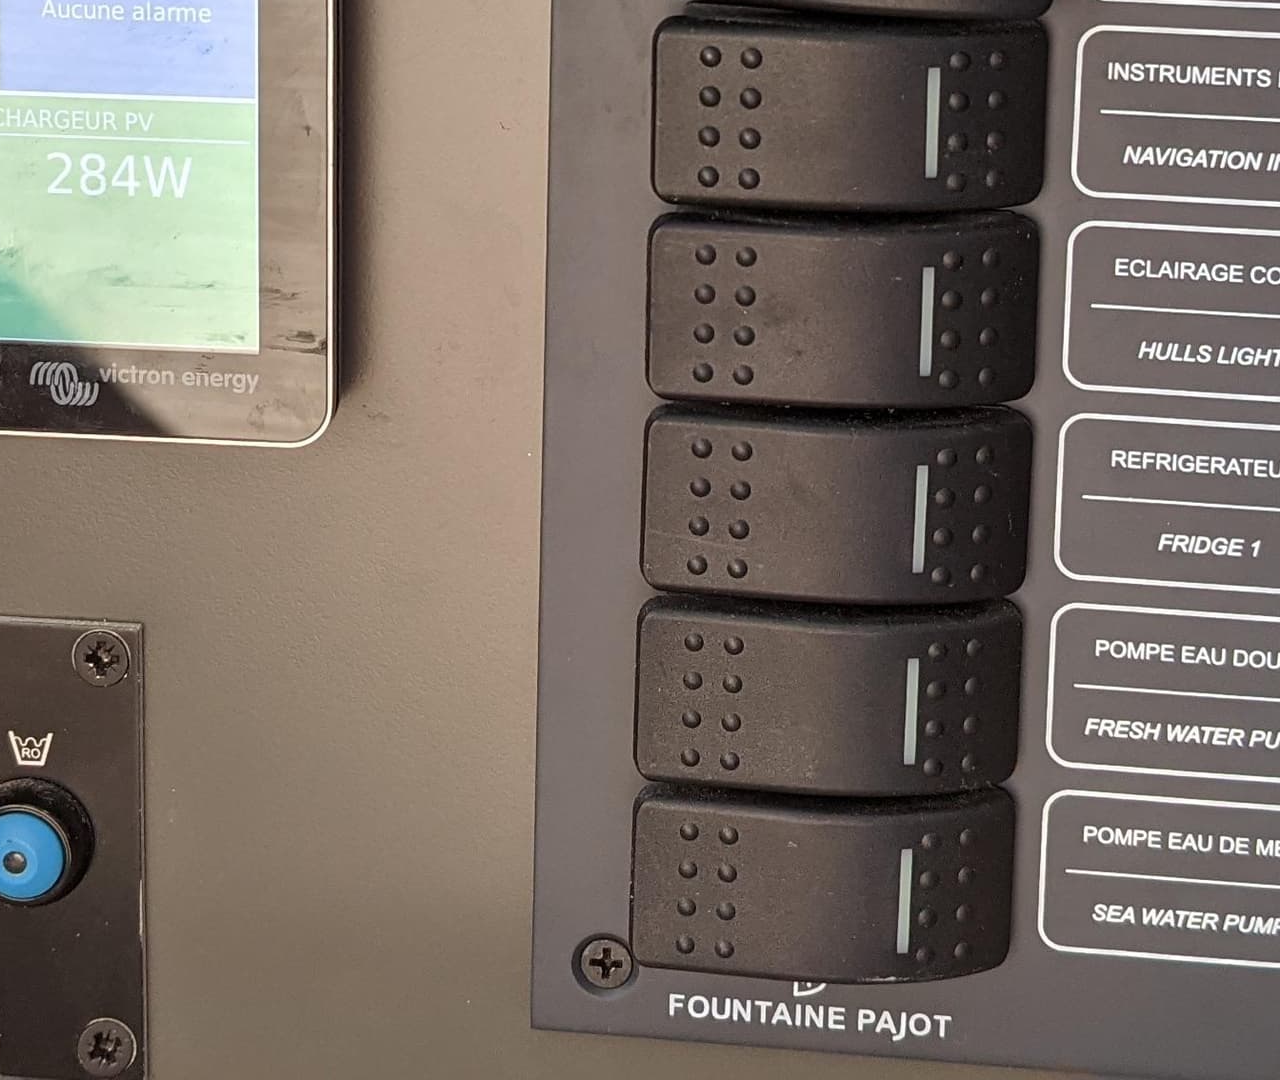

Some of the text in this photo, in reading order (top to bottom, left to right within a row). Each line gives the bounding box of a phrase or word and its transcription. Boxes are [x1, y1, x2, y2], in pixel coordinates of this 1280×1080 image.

[1107, 62, 1272, 88] INSTRUMENTS
[122, 109, 155, 134] PV
[1122, 145, 1263, 171] NAVIGATION
[46, 150, 194, 201] 284W
[1114, 258, 1244, 283] ECLAIRAGE
[1138, 340, 1213, 364] HULLS
[98, 362, 259, 395] victron energy
[1157, 533, 1261, 558] FRIDGE 1
[1095, 639, 1175, 663] POMPE
[1181, 645, 1227, 666] EAU
[1084, 717, 1162, 741] FRESH
[1166, 723, 1246, 747] WATER
[21, 748, 41, 759] RO
[1083, 825, 1162, 849] POMPE
[1168, 831, 1213, 852] EAU
[1219, 835, 1250, 855] DE
[1091, 903, 1136, 924] SEA
[1142, 907, 1220, 931] WATER
[668, 993, 952, 1042] FOUNTAINE PAJOT
